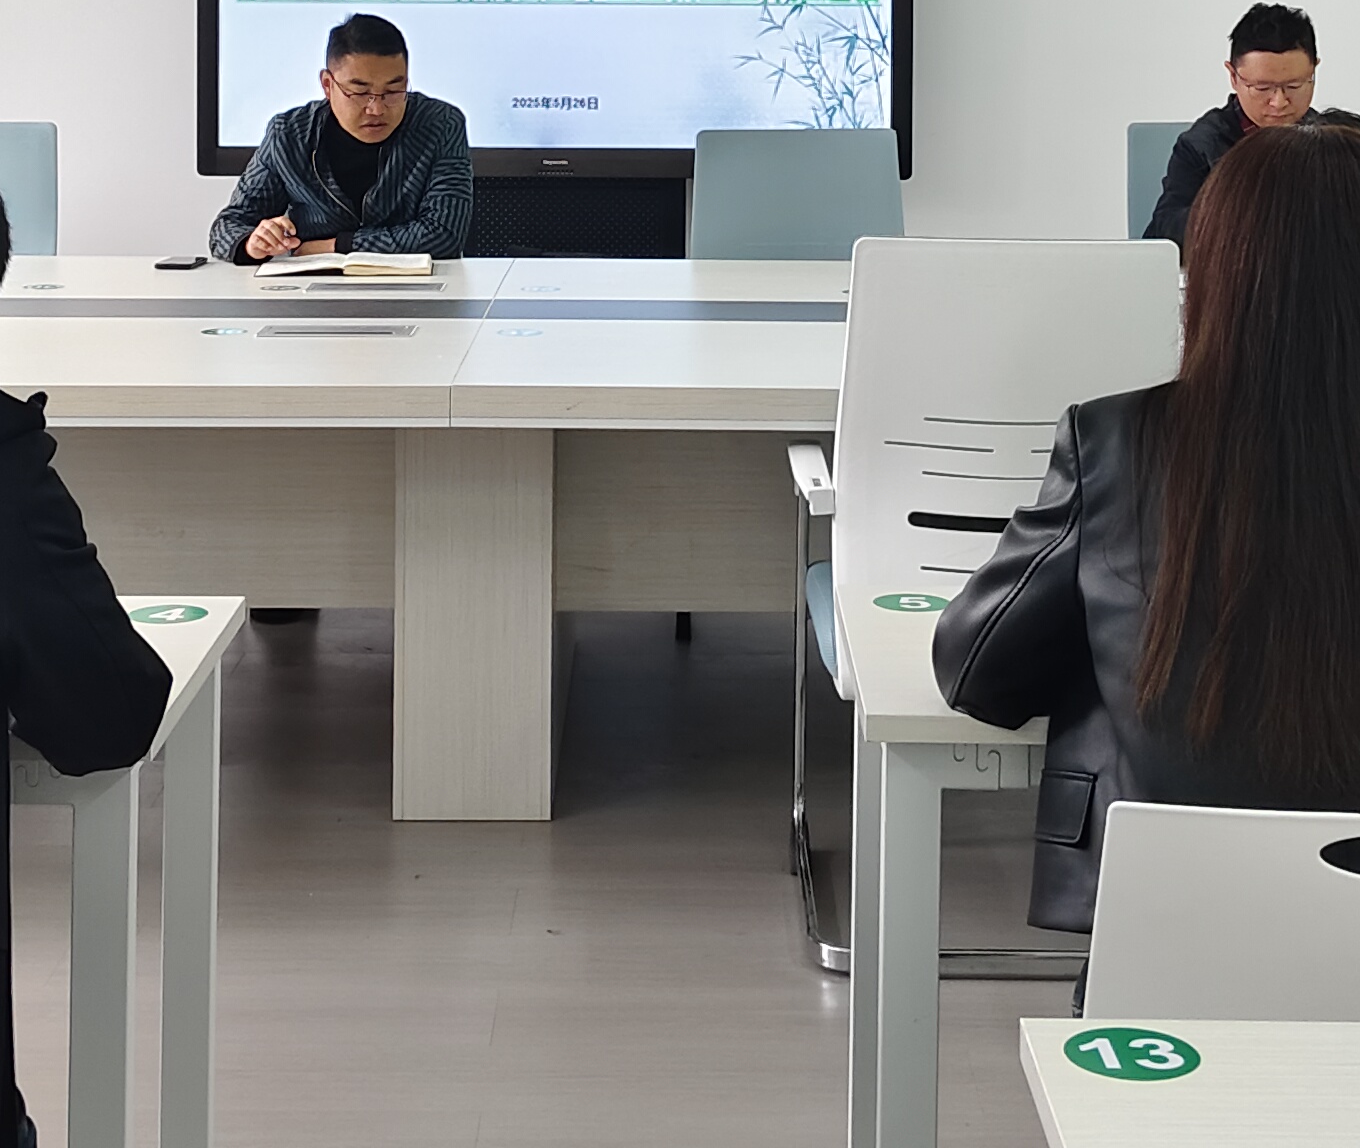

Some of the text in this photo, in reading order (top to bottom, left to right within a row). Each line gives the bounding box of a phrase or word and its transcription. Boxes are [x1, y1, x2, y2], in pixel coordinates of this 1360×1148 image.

[899, 596, 932, 609] 5
[148, 607, 186, 621] 4
[1077, 1037, 1186, 1071] 13
